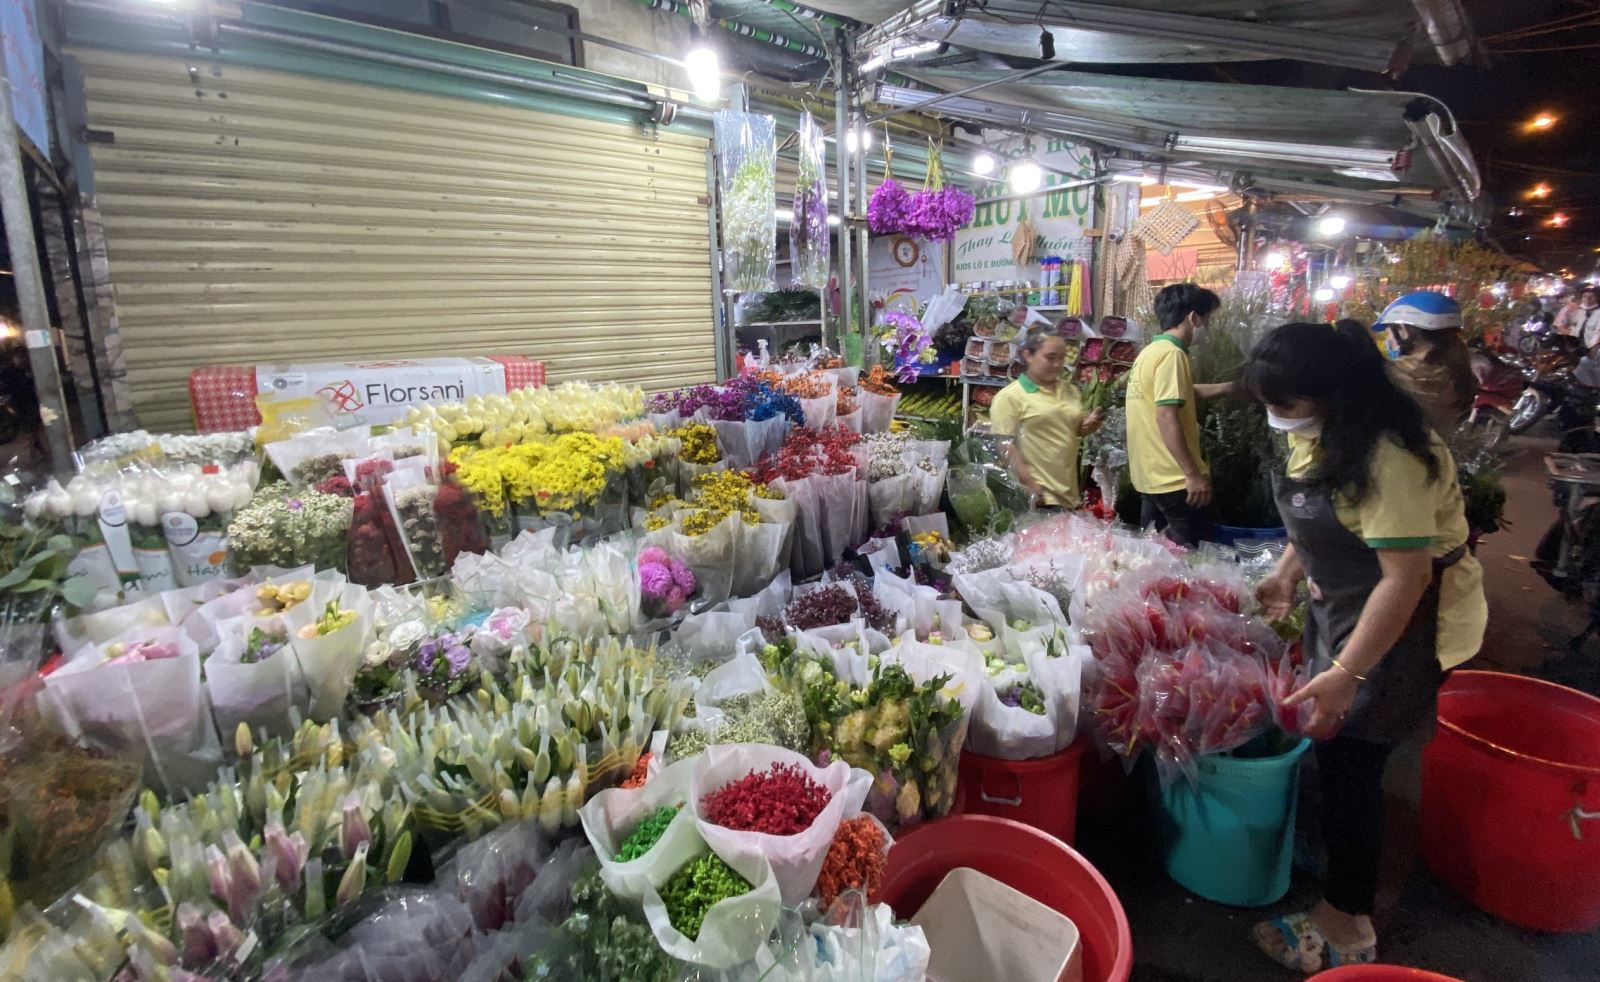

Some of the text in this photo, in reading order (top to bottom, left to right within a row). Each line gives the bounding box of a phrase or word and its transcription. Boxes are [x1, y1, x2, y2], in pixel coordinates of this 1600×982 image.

[956, 262, 971, 271] KIOS
[984, 260, 989, 269] E
[366, 380, 465, 405] Florsani
